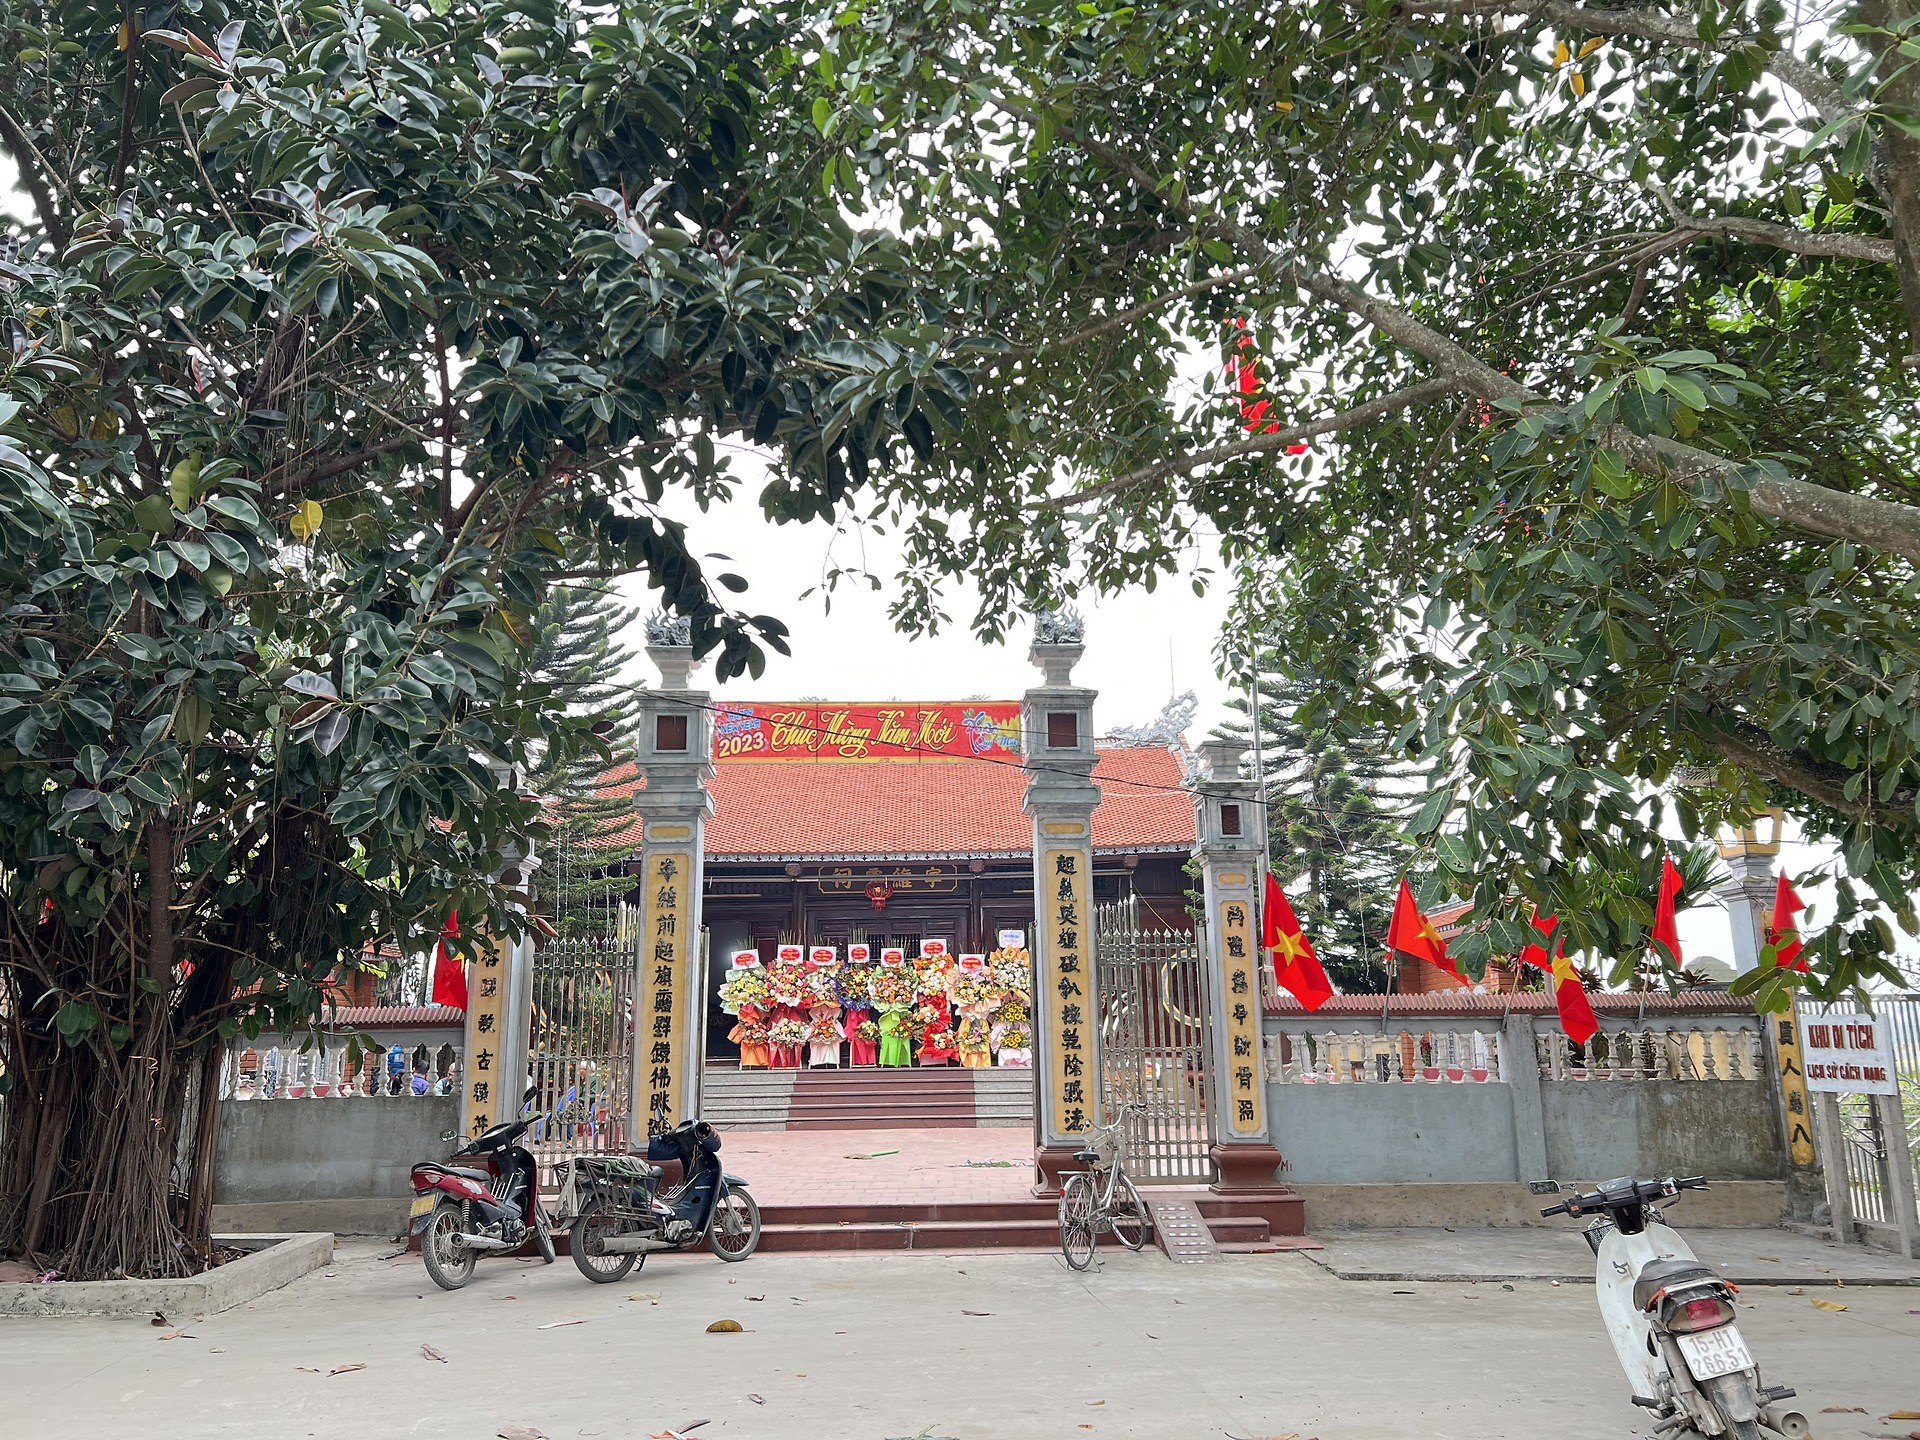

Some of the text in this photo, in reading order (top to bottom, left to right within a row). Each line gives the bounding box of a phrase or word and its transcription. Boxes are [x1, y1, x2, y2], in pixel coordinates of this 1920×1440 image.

[718, 730, 765, 758] 2023
[770, 710, 959, 758] Chúc Mừng Năm Mới
[1808, 1020, 1876, 1050] KHU DI TÍCH
[1806, 1064, 1825, 1080] LỊCH
[1840, 1062, 1861, 1080] CÁCH
[1863, 1066, 1887, 1083] MẠNG
[1689, 1329, 1735, 1355] 15-H1
[1692, 1346, 1751, 1376] 266.51
